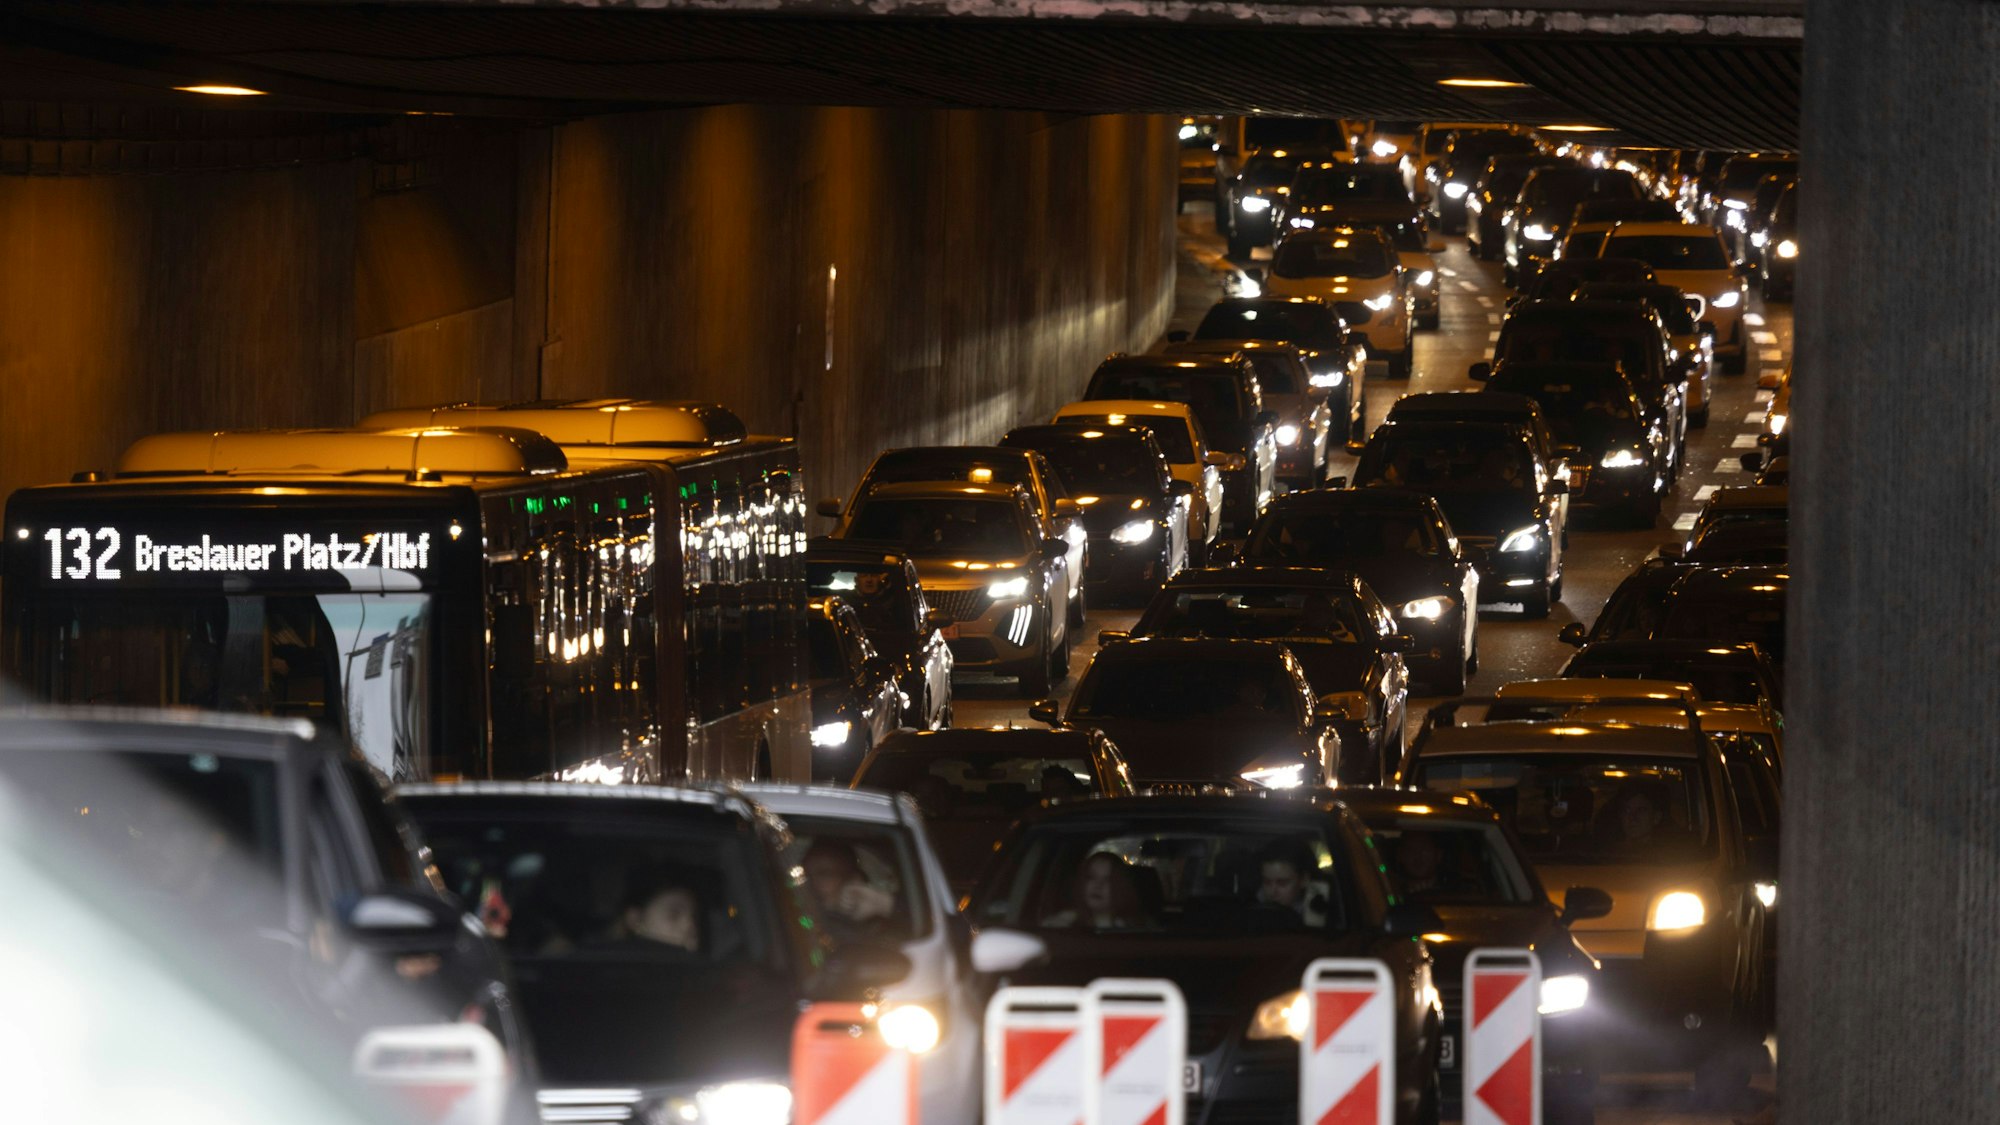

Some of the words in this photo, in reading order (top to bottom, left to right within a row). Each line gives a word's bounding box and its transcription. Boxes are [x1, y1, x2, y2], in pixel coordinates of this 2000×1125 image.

[45, 527, 120, 579] 132
[135, 534, 276, 571] Breslauer
[283, 532, 430, 570] Platz/Hbf
